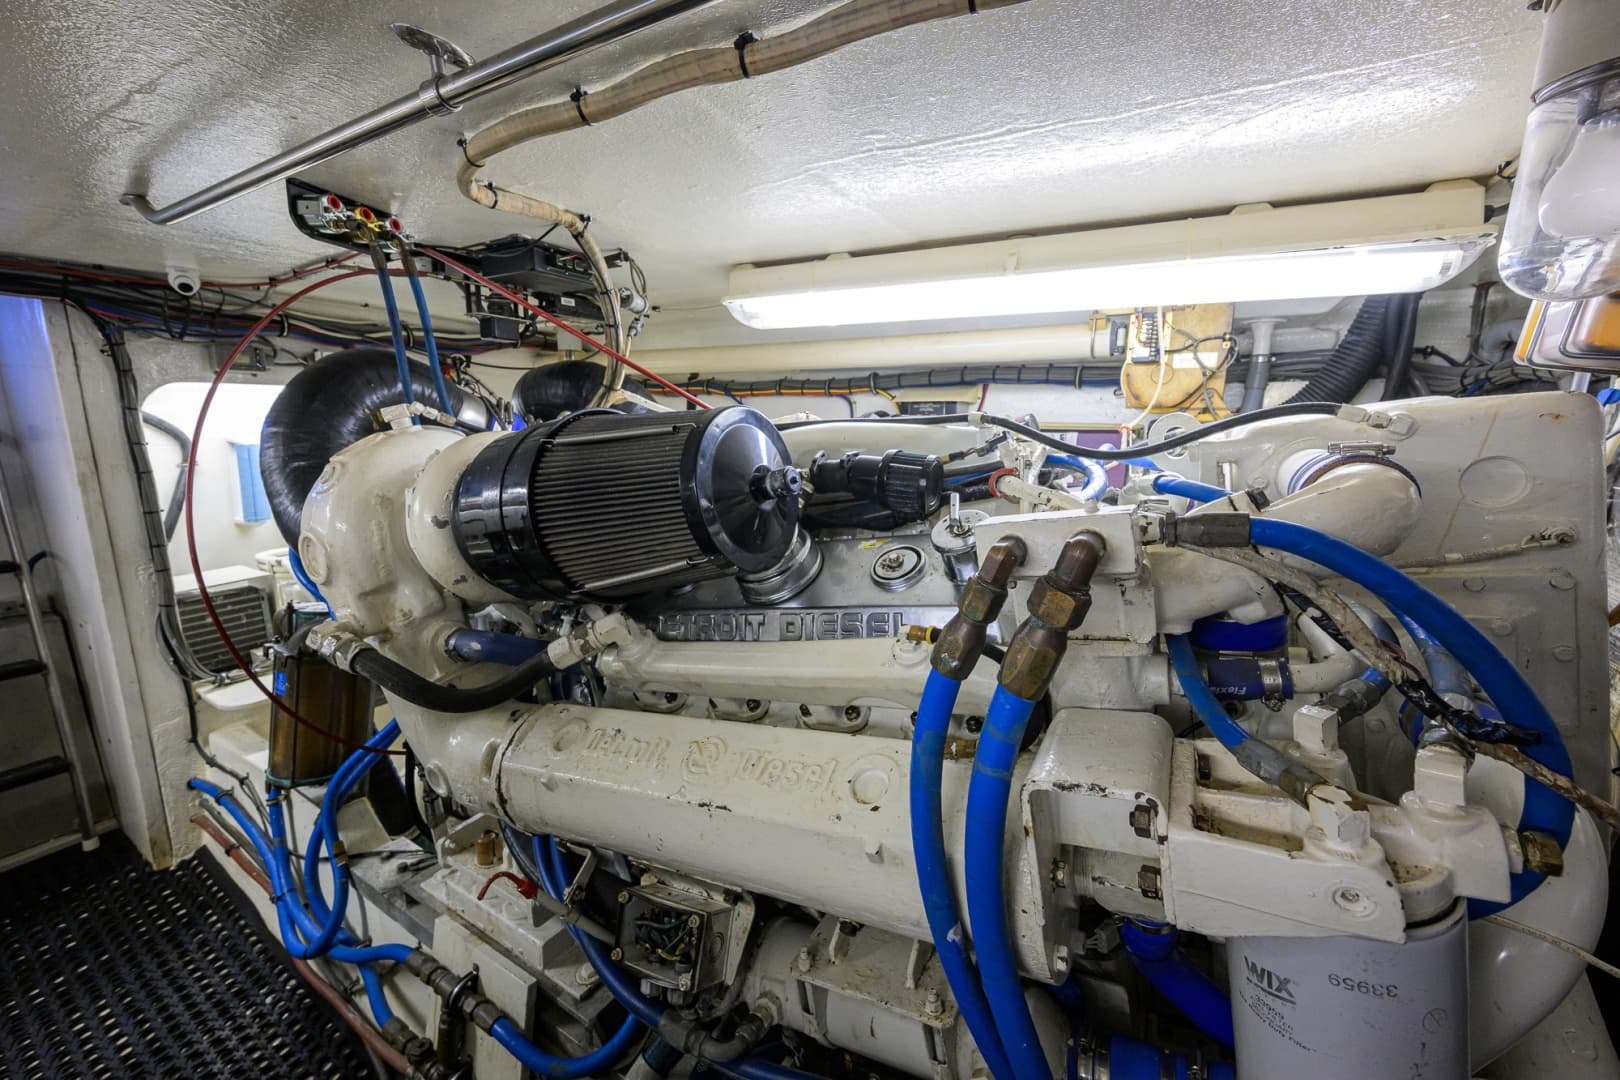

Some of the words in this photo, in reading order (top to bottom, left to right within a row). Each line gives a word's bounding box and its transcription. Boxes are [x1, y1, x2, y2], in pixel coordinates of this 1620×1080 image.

[657, 613, 765, 641] ETROIT
[1244, 955, 1297, 999] WIX
[1327, 973, 1399, 998] 33959
